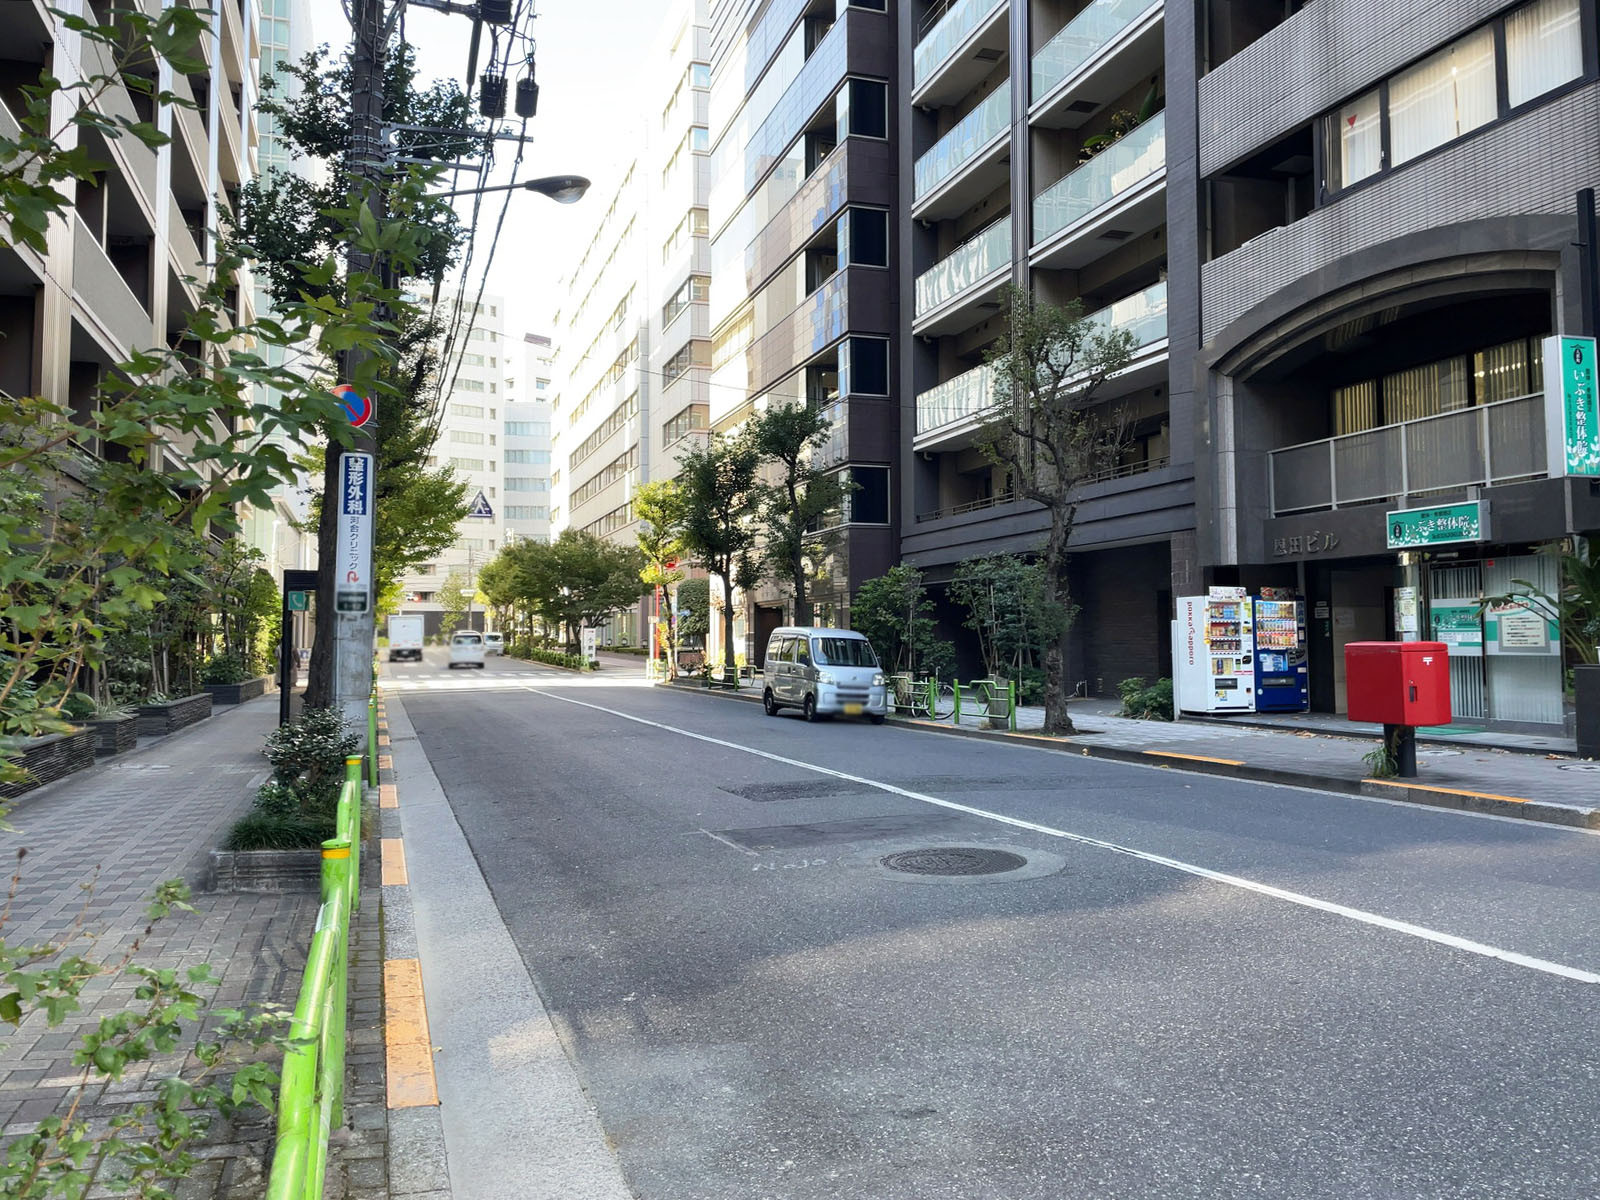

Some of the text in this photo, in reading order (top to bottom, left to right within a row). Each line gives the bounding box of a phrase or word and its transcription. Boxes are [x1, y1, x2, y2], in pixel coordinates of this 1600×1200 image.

[347, 457, 364, 515] 整形外科
[349, 516, 360, 570] 河合クリニック
[1405, 515, 1470, 533] いぶき整体院
